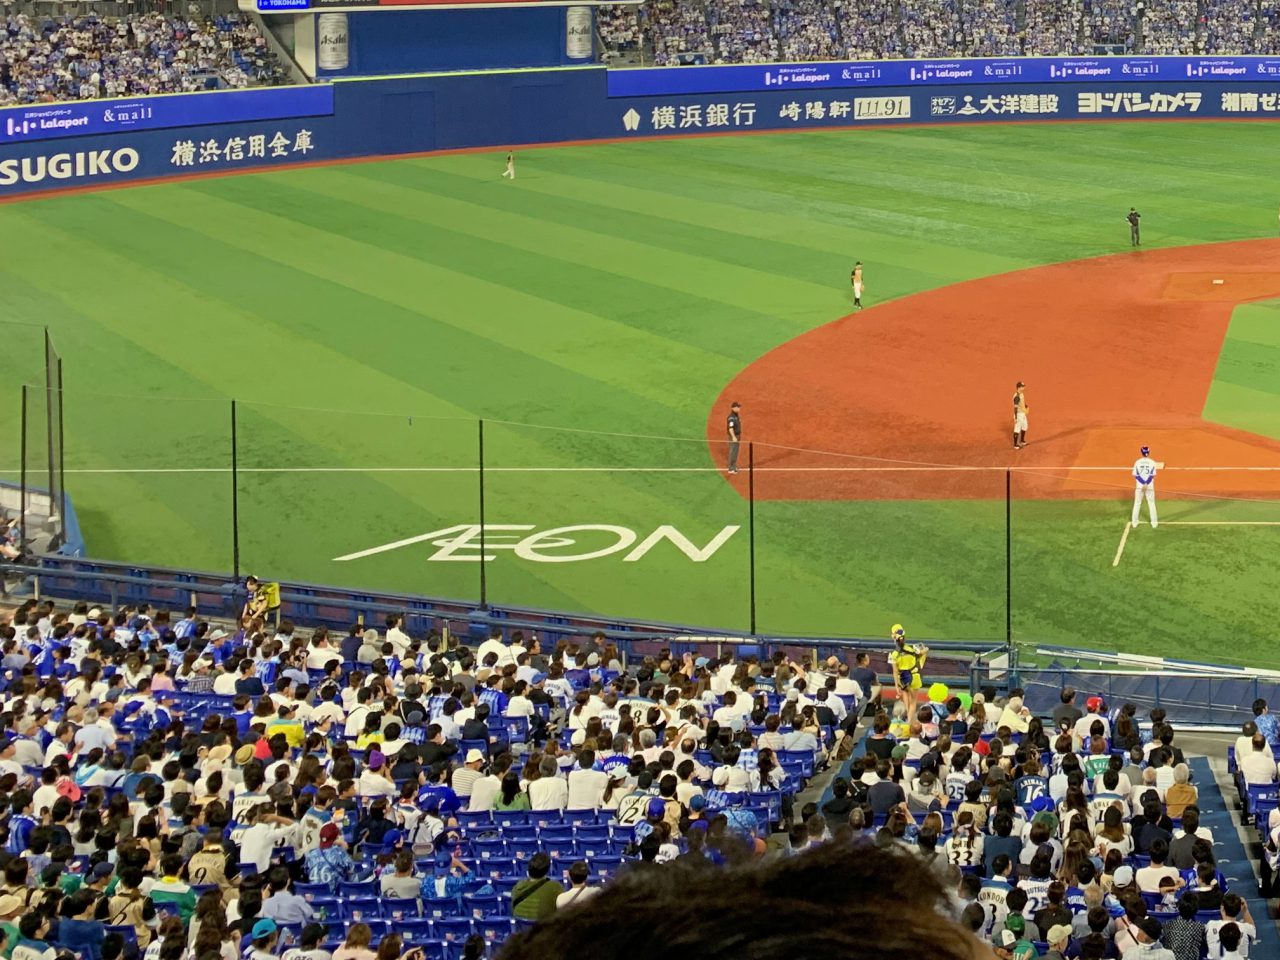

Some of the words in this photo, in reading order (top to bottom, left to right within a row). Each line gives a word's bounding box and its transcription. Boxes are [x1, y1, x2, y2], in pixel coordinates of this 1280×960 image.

[320, 33, 347, 46] Asahi
[791, 72, 830, 83] LaLaport
[936, 69, 973, 79] LaLaport
[1075, 67, 1111, 77] LaLaport
[1211, 66, 1247, 76] LaLaport
[932, 106, 955, 114] グループ
[980, 94, 1059, 114] 大洋建設
[1078, 93, 1202, 113] ヨドバシカメラ
[651, 103, 756, 130] 横浜銀行
[779, 101, 851, 122] 崎陽軒
[41, 116, 88, 129] LaLaport
[170, 128, 315, 167] 横浜信用金庫
[949, 785, 965, 800] 25
[1024, 785, 1043, 803] 16
[305, 831, 312, 845] 6
[951, 850, 972, 866] 33
[194, 867, 207, 885] 9
[308, 866, 331, 882] 46
